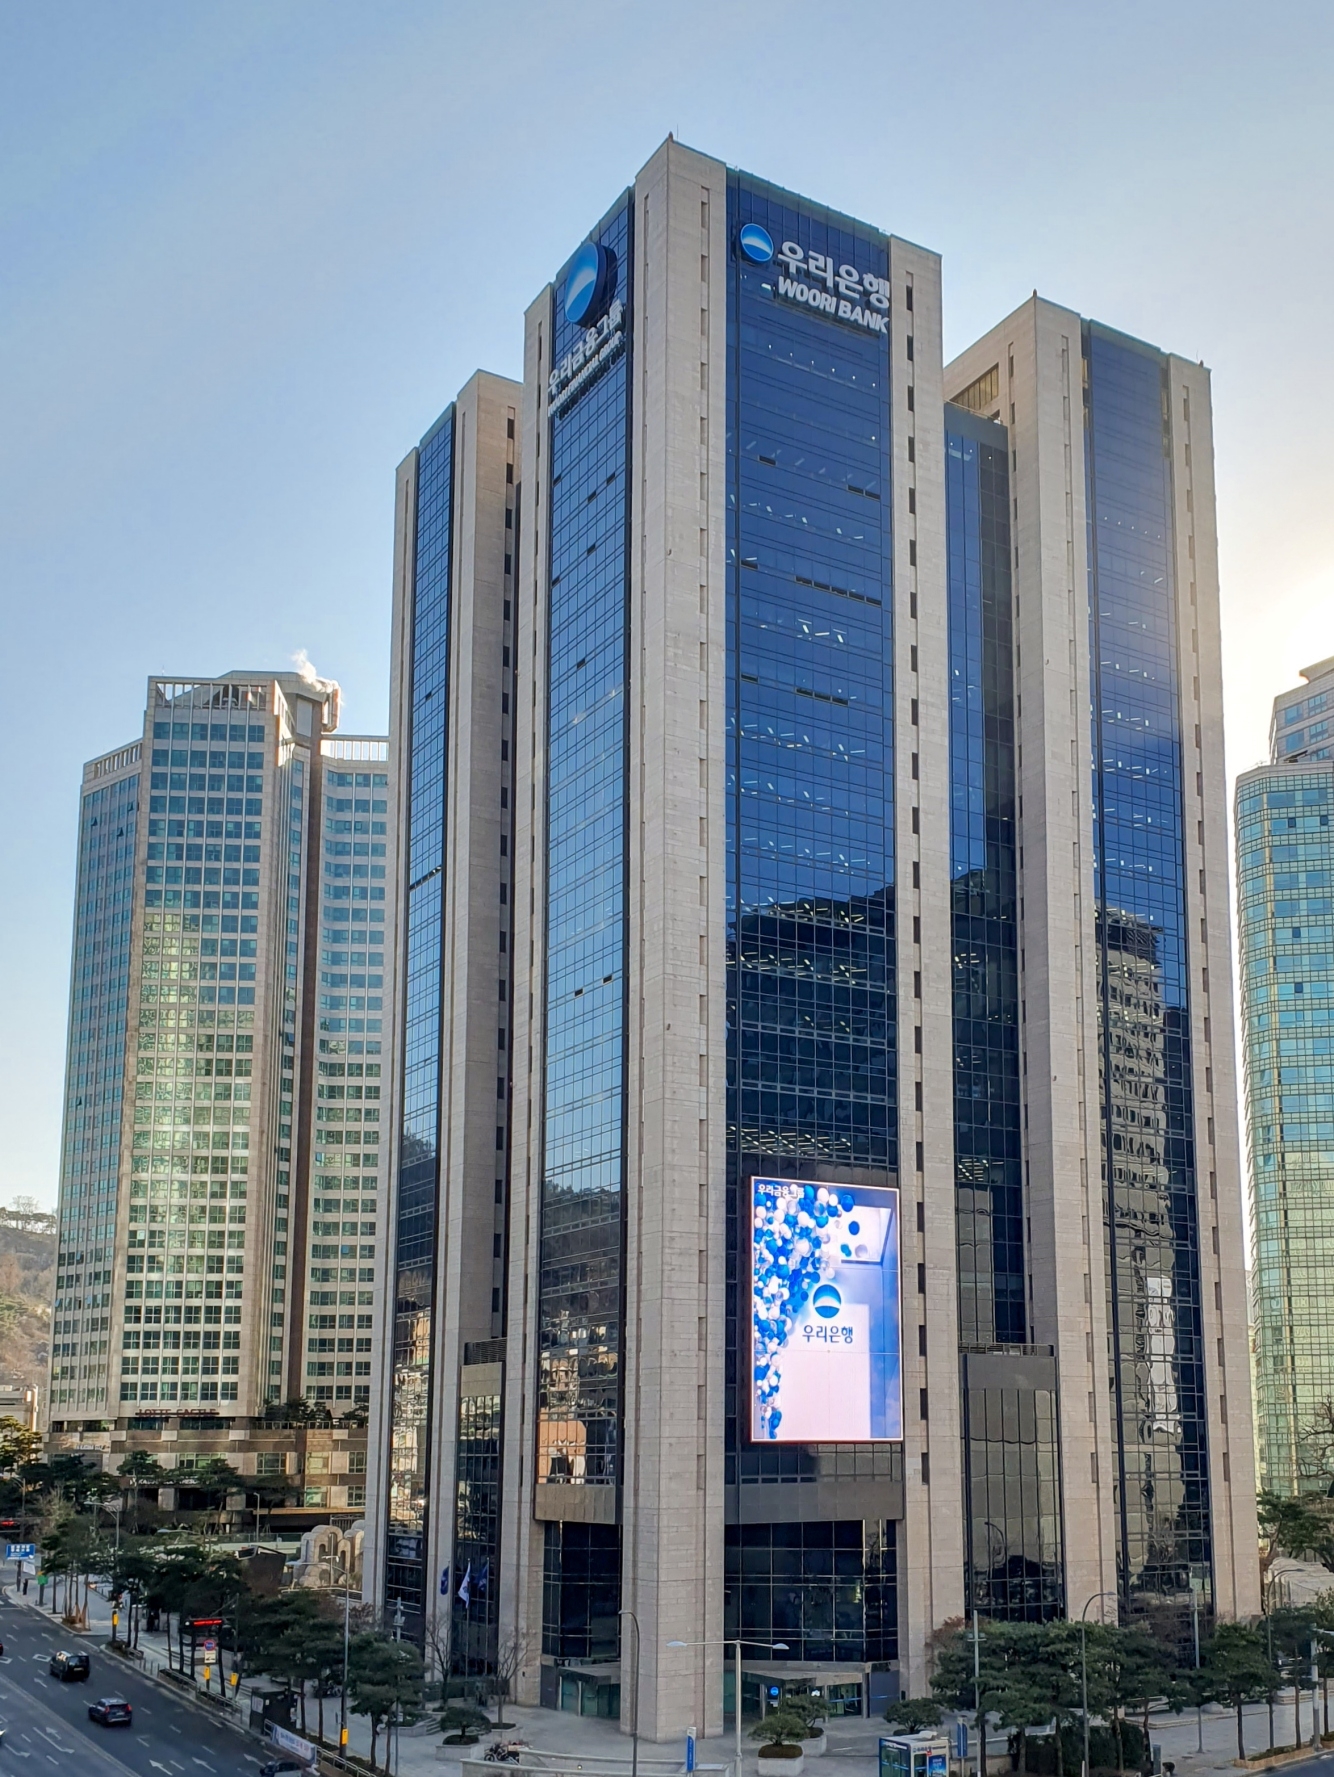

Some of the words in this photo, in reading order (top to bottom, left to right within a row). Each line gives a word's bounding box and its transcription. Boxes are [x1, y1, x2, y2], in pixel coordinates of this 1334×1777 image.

[777, 241, 890, 309] 우리은행
[778, 275, 837, 315] WOORI
[838, 300, 890, 334] BANK
[547, 298, 623, 396] 우리금융그룹
[758, 1183, 805, 1199] 우리금융그룹
[802, 1324, 853, 1344] 우리은행
